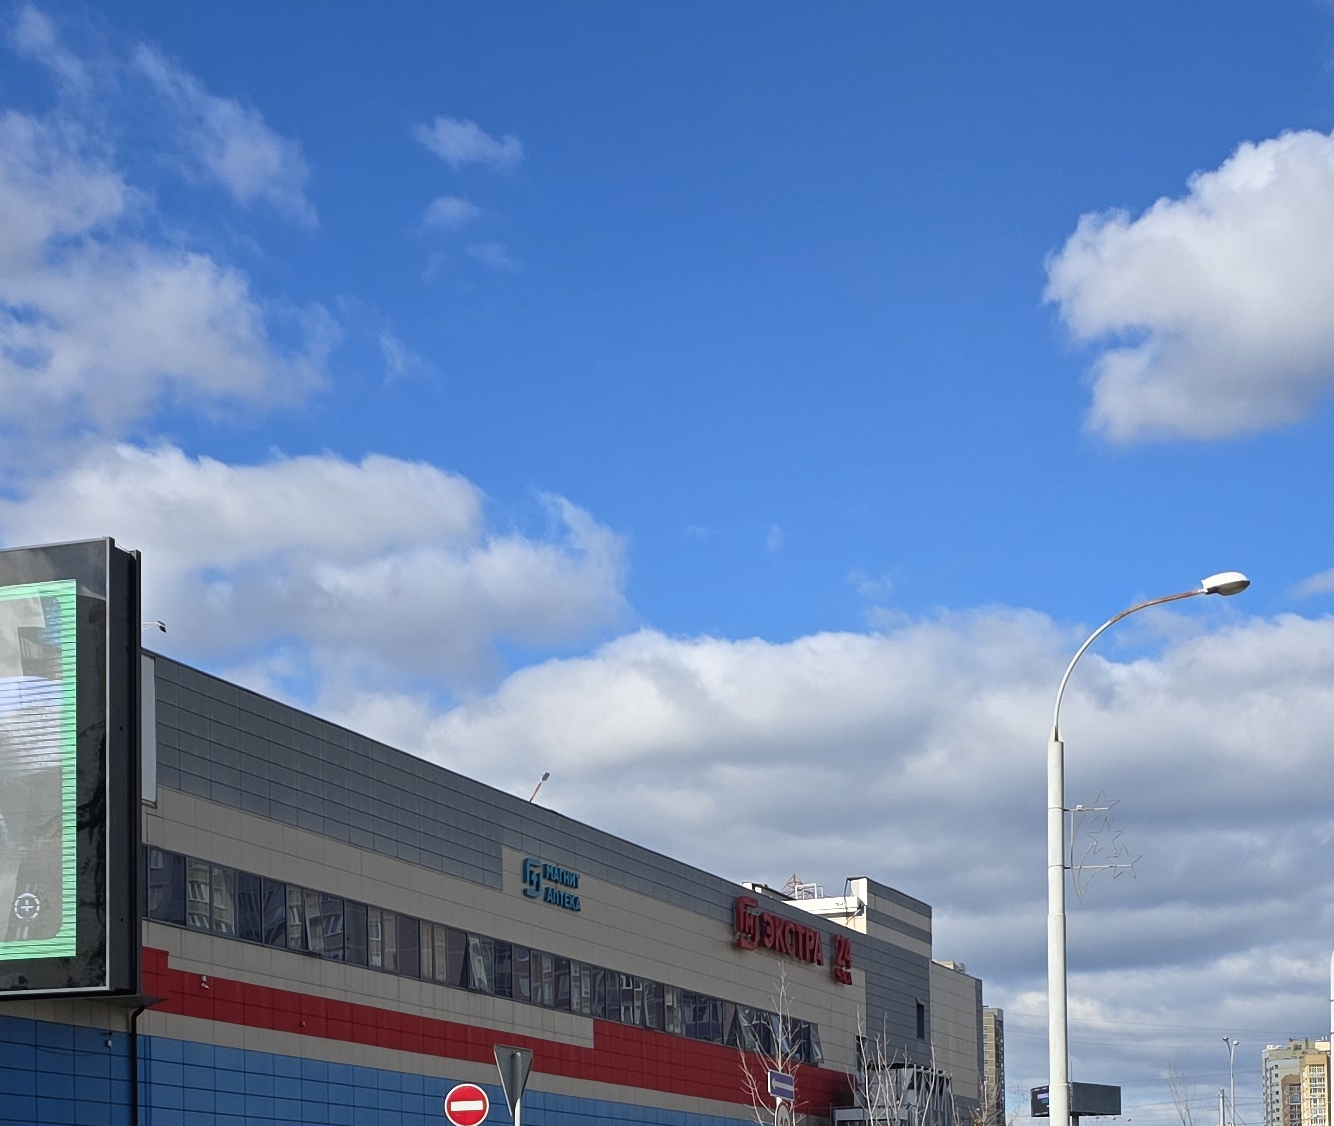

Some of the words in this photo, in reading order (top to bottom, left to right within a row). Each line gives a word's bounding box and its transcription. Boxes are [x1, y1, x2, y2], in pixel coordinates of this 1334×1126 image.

[543, 863, 580, 889] МАГНИТ
[543, 886, 581, 911] АПТЕКА
[760, 911, 824, 966] ЭКСТРА
